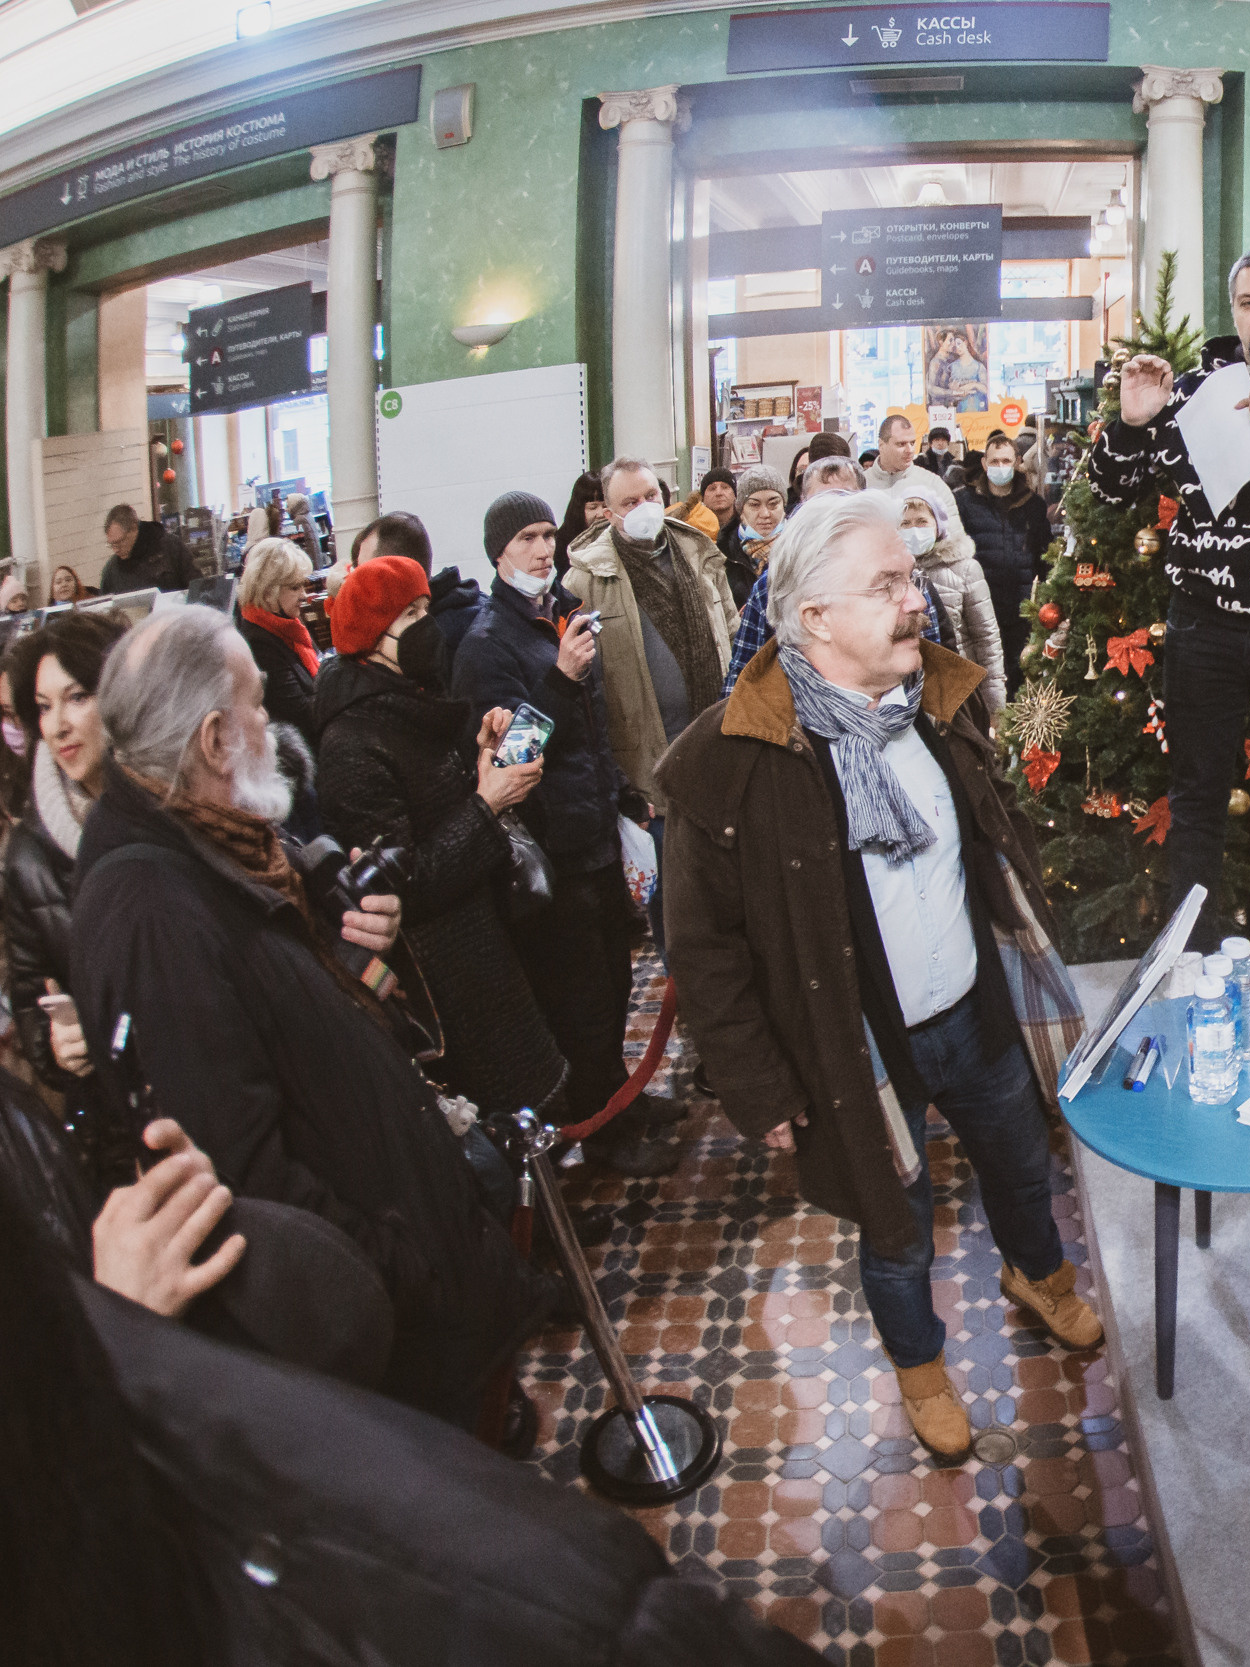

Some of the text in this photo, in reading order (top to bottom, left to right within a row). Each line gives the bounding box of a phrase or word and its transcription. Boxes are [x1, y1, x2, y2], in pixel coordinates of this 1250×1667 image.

[917, 16, 976, 30] КАССЫ
[916, 30, 992, 46] Cash desk
[94, 111, 286, 181] МОДА И СТИЛЬ ИСТОРИЯ КОСТЮМА
[127, 169, 146, 183] and
[146, 162, 169, 178] style
[173, 154, 191, 167] The
[192, 143, 226, 164] history
[228, 138, 240, 151] of
[241, 127, 287, 147] costume
[886, 221, 990, 234] ОТКРЫТКИ, КОНВЕРТЫ
[886, 231, 969, 243] Postcard, envelopes
[886, 253, 994, 265] ПУТЕВОДИТЕЛИ, КАРТЫ
[886, 264, 959, 275] Guidebooks, maps
[886, 288, 917, 297] КАССЫ
[886, 297, 925, 308] Cash desk
[280, 330, 302, 341] КАРТЫ
[799, 400, 820, 412] -25%
[933, 413, 938, 421] 3
[947, 412, 953, 421] 2
